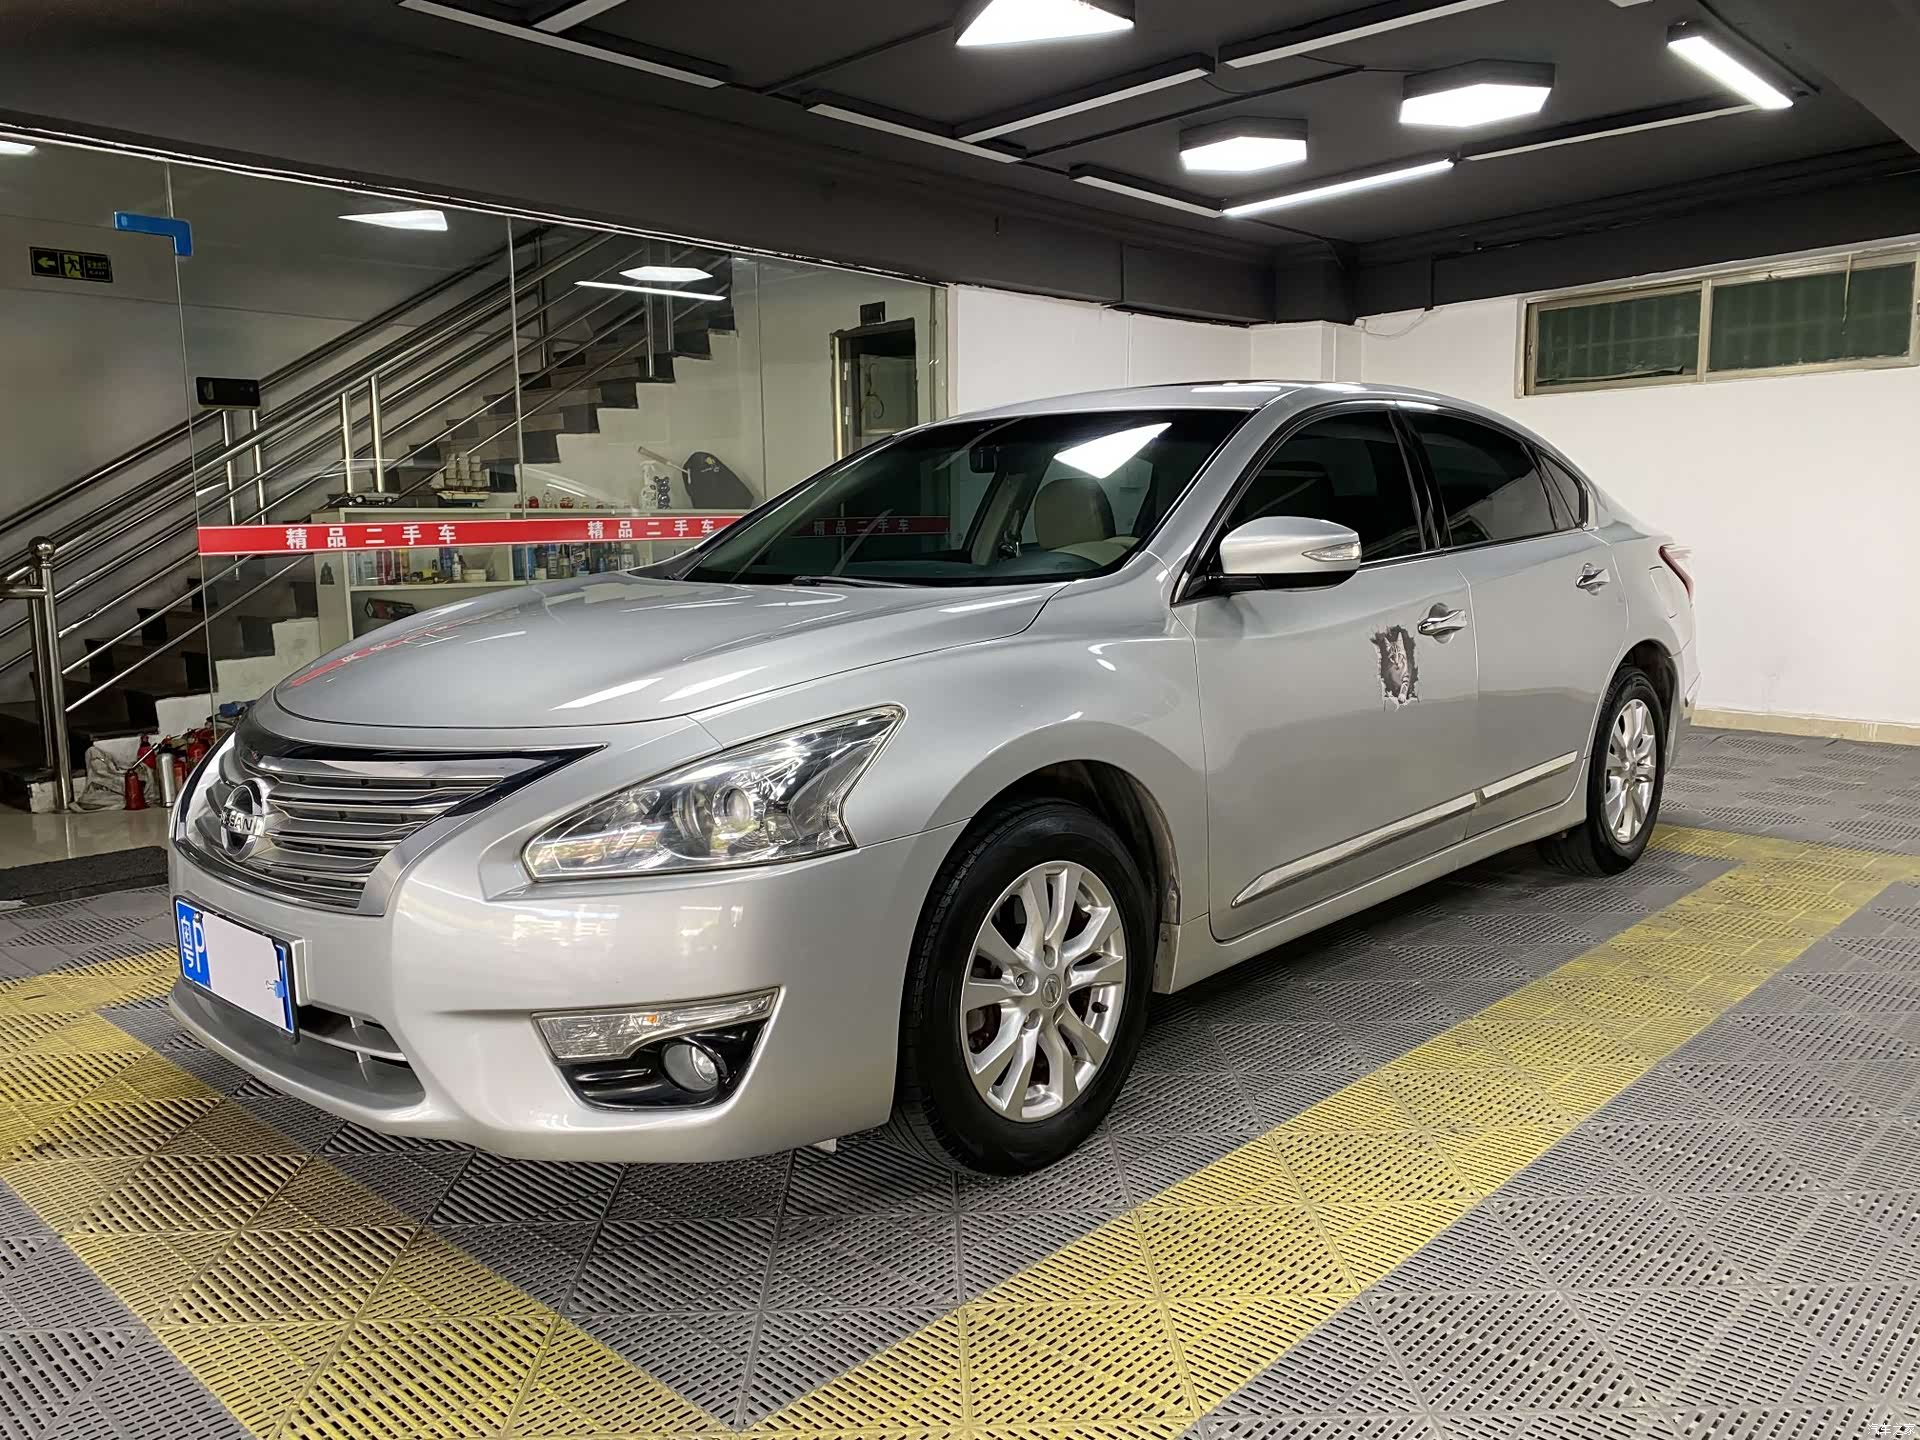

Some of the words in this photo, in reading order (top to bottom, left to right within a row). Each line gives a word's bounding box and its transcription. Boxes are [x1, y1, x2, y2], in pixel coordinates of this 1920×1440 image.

[286, 525, 456, 549] 精品二手车
[587, 520, 714, 539] 精品二手车
[814, 519, 909, 535] 精品二手车
